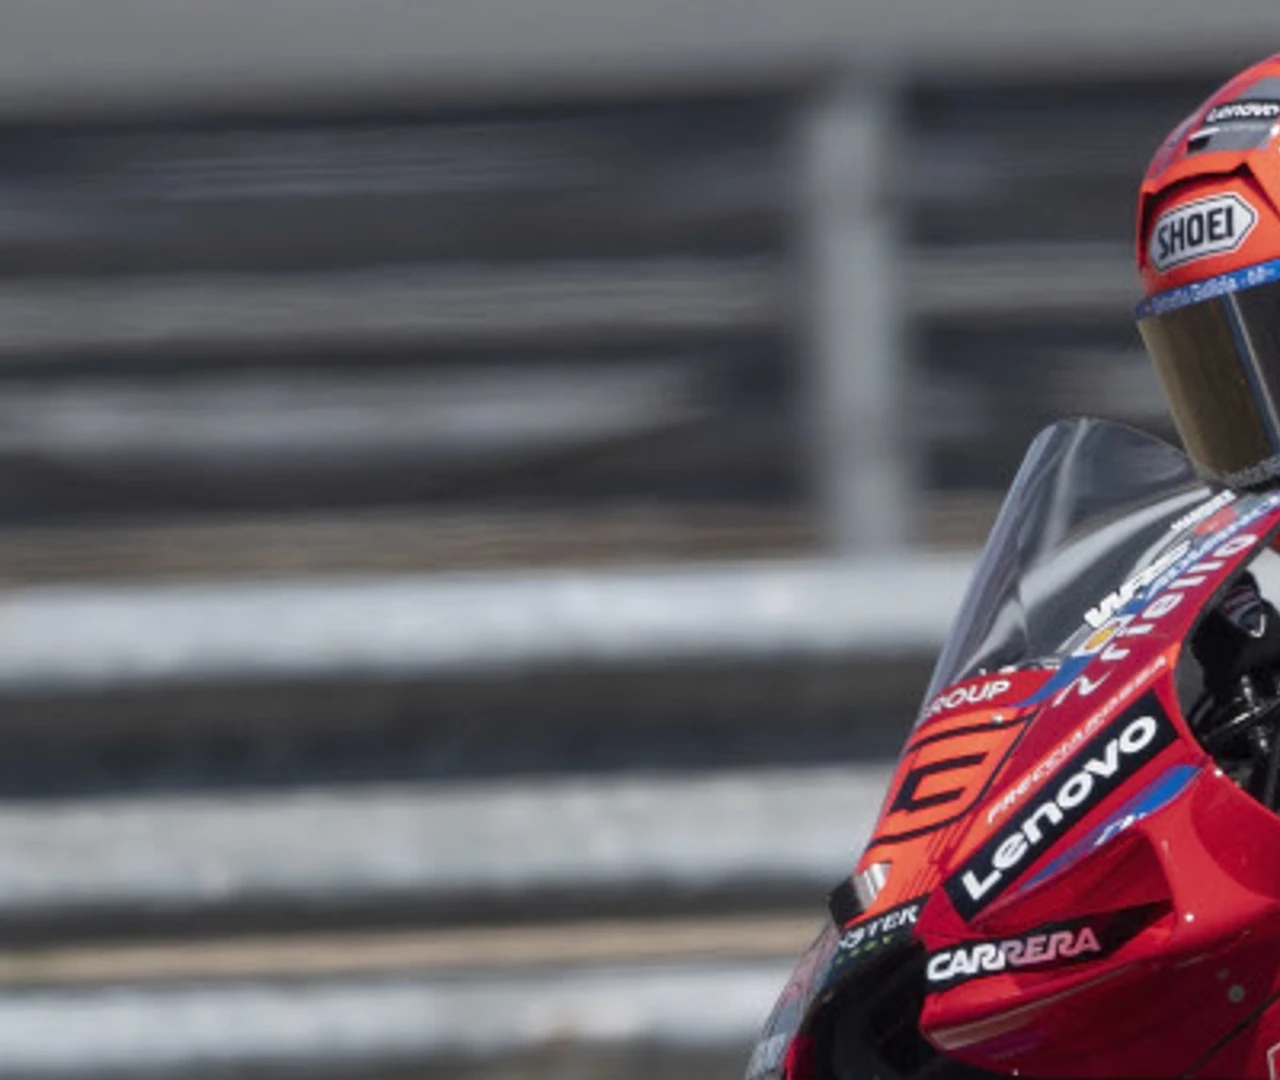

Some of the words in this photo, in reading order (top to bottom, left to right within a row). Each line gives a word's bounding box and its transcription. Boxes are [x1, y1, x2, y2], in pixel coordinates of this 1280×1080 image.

[1157, 206, 1235, 259] SHOEI
[961, 715, 1158, 901] Lenovo
[927, 927, 1101, 982] CARRERA
